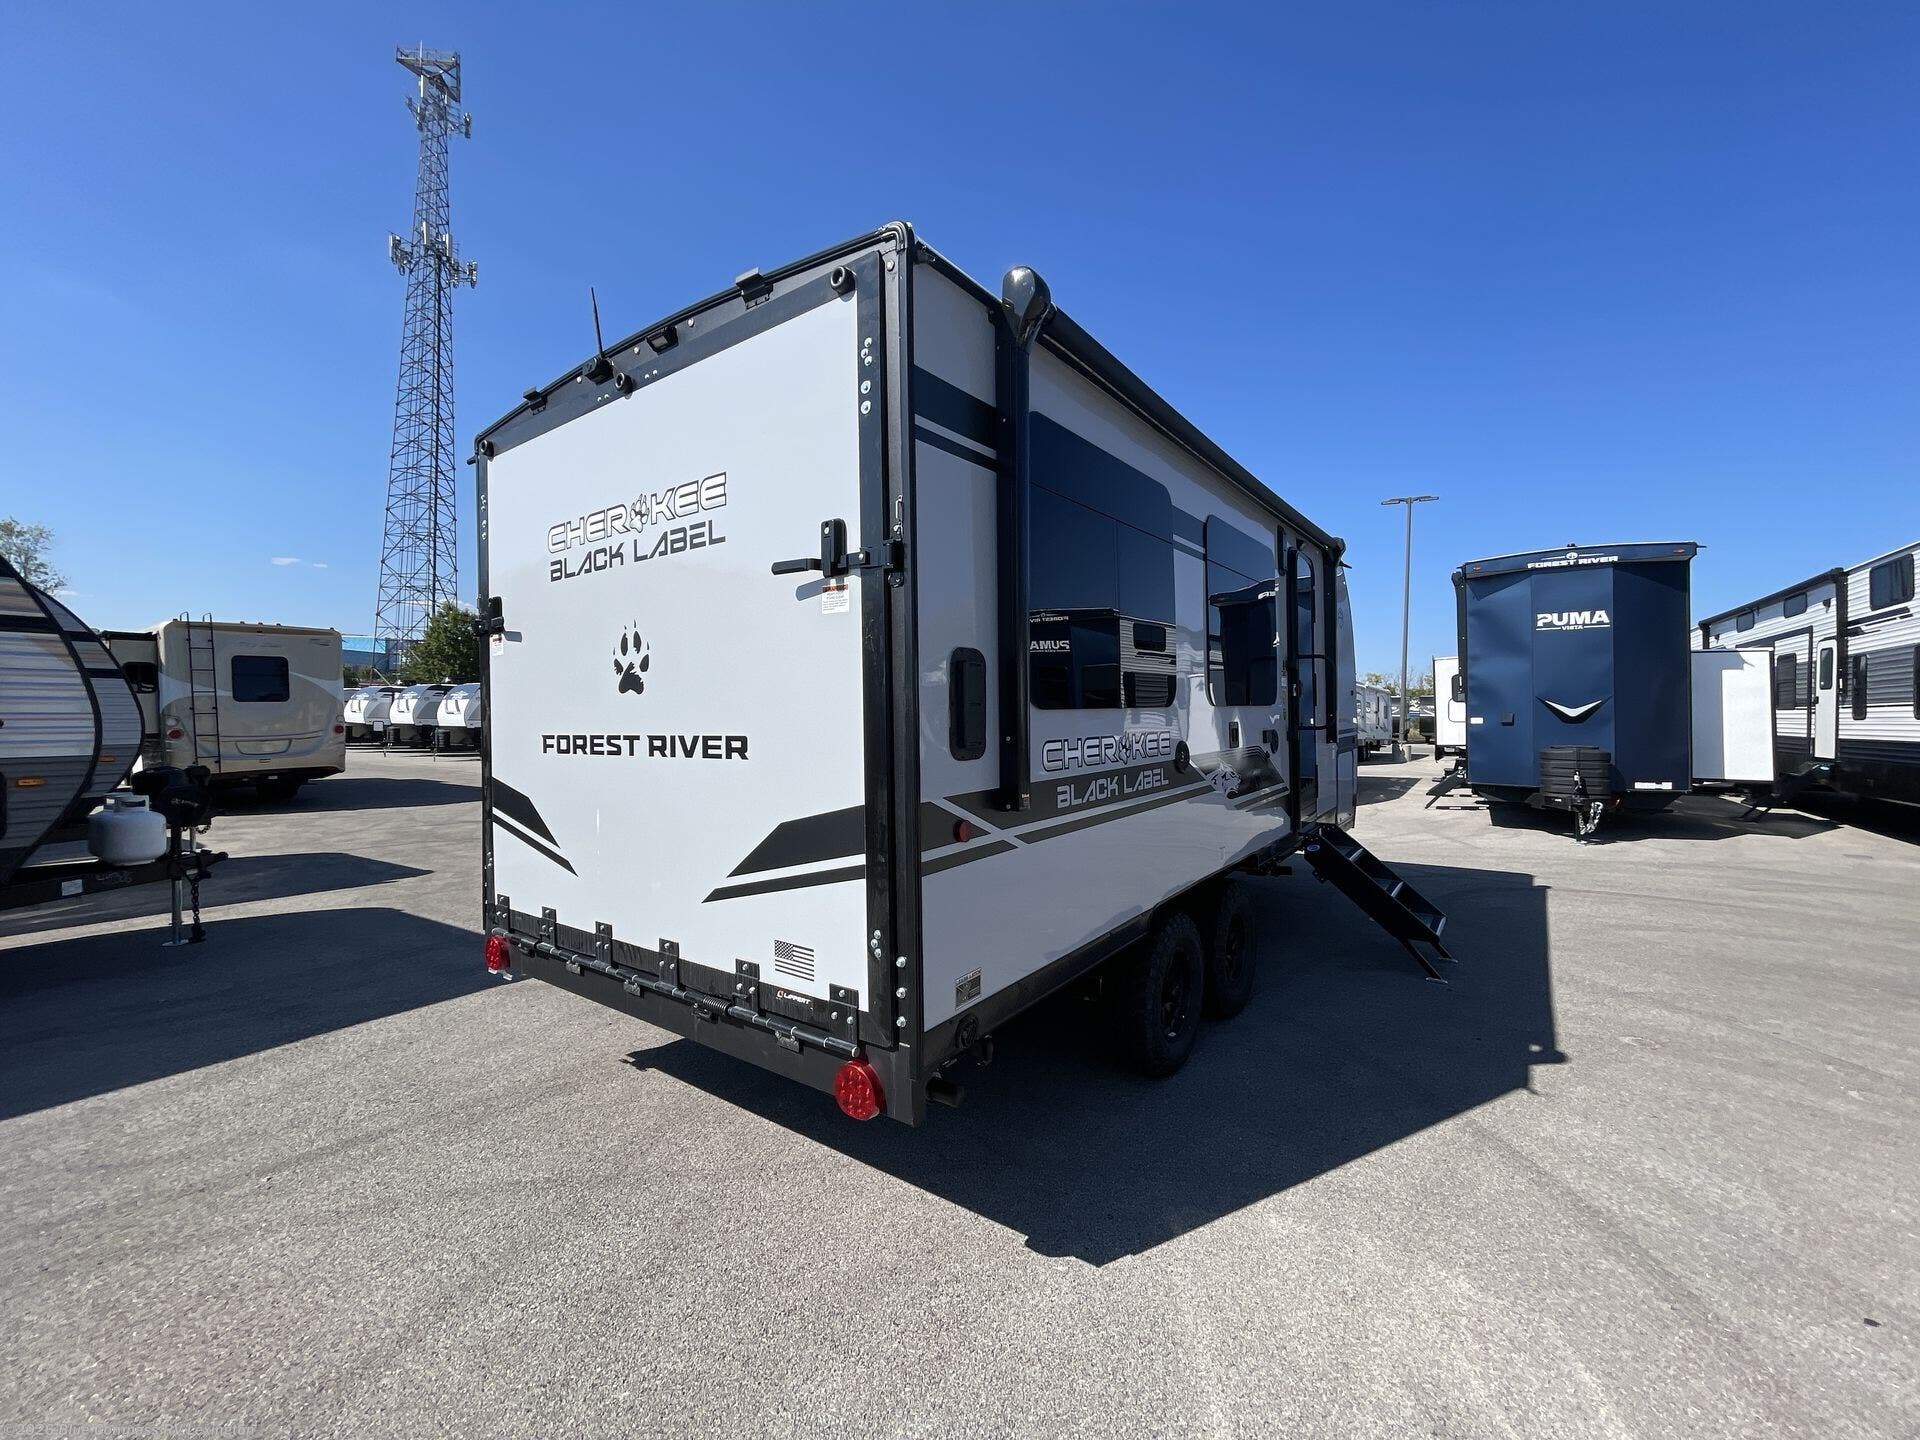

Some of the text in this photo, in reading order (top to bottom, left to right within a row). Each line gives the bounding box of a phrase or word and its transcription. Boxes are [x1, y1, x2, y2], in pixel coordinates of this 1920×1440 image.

[548, 472, 726, 553] CHEROKEE
[550, 520, 726, 582] BLACK LABEL
[1527, 556, 1619, 569] FOREST RIVER
[1536, 610, 1610, 627] PUMA
[541, 734, 749, 760] FOREST RIVER
[1042, 731, 1171, 772] CHEROKEE
[1057, 776, 1119, 809] BLACK
[1124, 767, 1169, 795] LABEL
